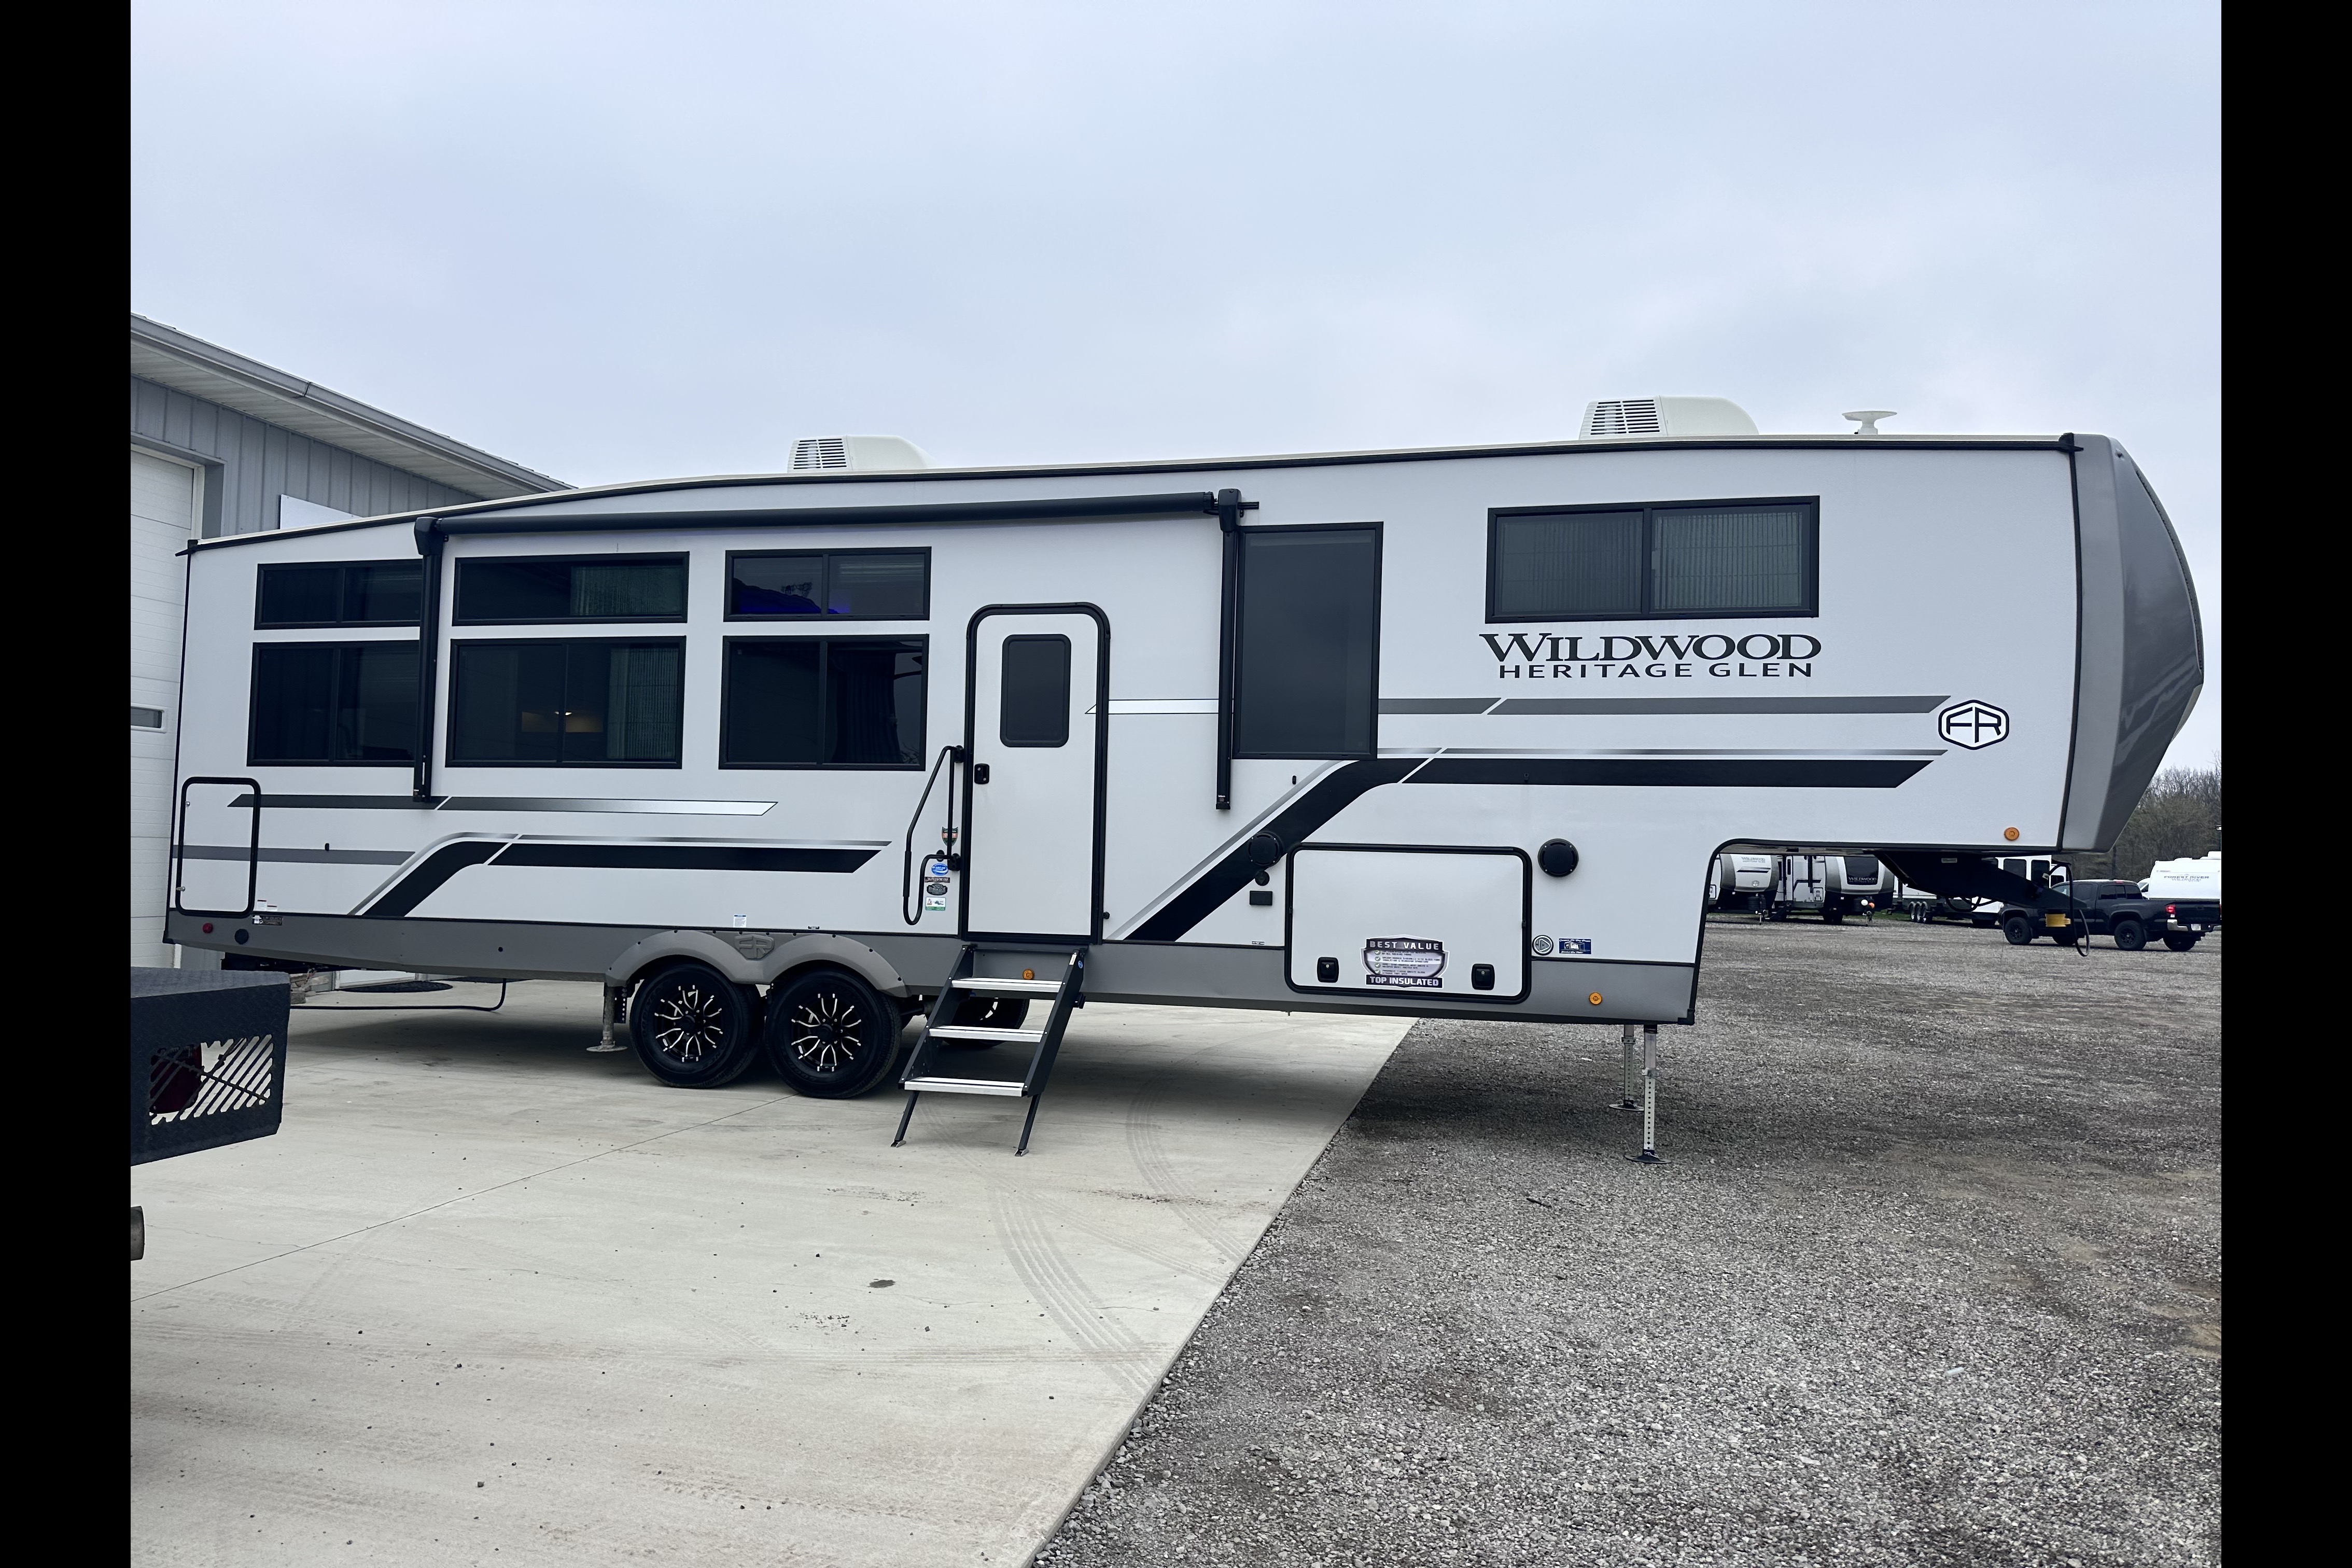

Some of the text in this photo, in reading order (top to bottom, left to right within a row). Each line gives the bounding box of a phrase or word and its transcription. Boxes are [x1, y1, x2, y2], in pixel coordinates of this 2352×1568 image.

[1479, 633, 1822, 662] WILDWOOD
[1499, 662, 1811, 678] HERITAGE GLEN
[1946, 706, 2002, 744] FR
[1369, 940, 1439, 950] BEST VALUE
[1369, 976, 1439, 986] TOP INSULATED
